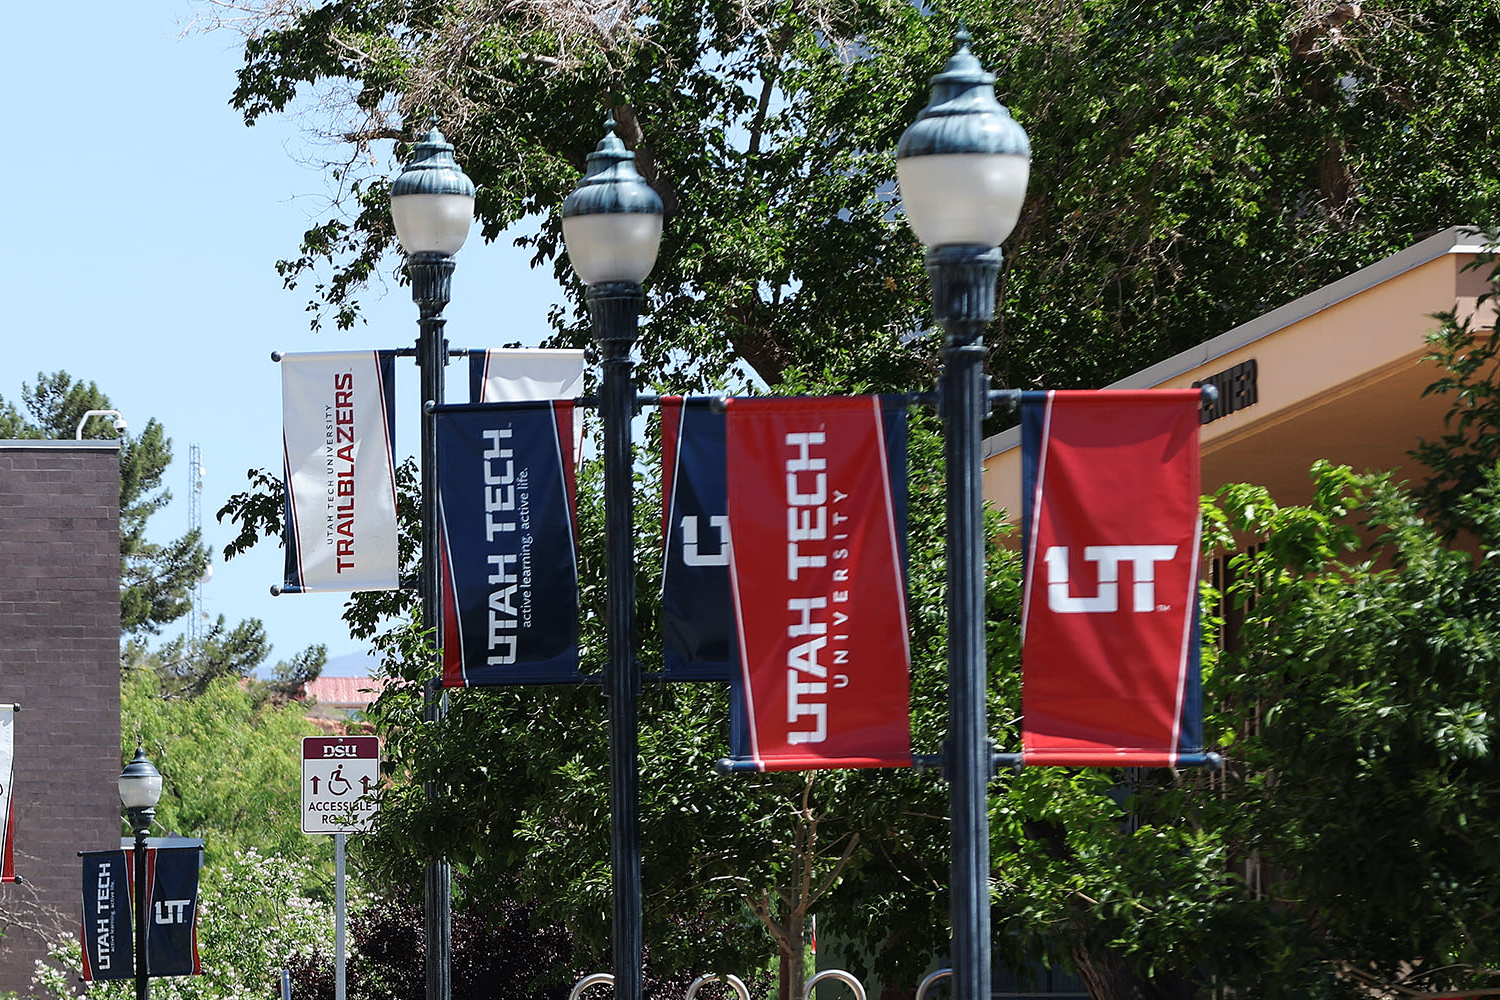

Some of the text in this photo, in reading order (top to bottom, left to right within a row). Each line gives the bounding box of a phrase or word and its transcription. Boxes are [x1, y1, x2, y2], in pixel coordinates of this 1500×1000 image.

[325, 404, 334, 545] UTAH TECH UNIVERSITY
[335, 372, 355, 574] TRAILBLAZERS
[483, 428, 518, 666] UTAH TECH
[520, 467, 533, 628] active learning. active life.
[785, 431, 827, 746] UTAH TECH
[833, 489, 849, 689] UNIVERSITY
[1044, 545, 1178, 613] UT
[308, 802, 372, 812] ACCESSIBLE
[323, 745, 357, 758] DSU
[97, 863, 110, 970] UTAH TECH
[154, 899, 190, 925] UT
